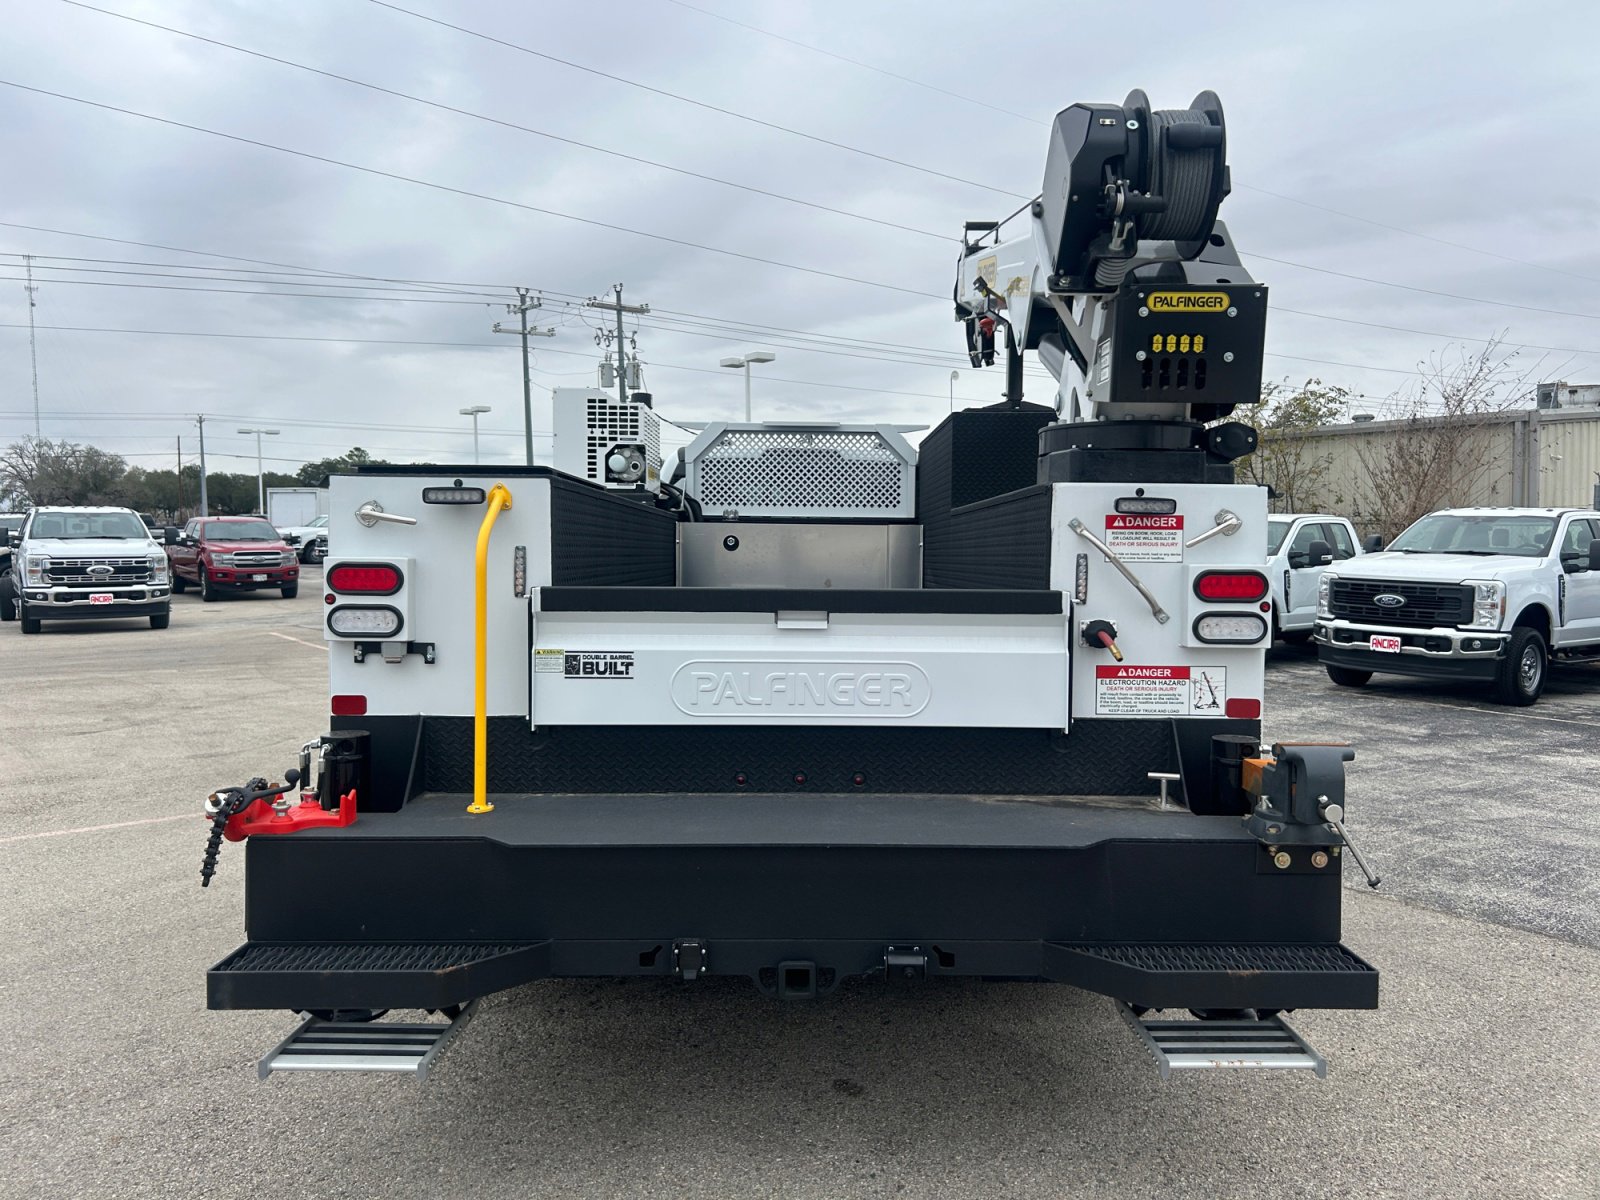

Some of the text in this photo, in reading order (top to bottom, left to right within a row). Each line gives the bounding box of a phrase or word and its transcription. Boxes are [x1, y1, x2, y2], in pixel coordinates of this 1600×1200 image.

[1153, 296, 1224, 308] PALFINGER
[1126, 517, 1177, 526] DANGER
[1372, 638, 1399, 650] ANCIRA
[582, 662, 634, 675] BUILT
[1128, 668, 1171, 677] DANGER
[690, 672, 912, 706] PALFINGER
